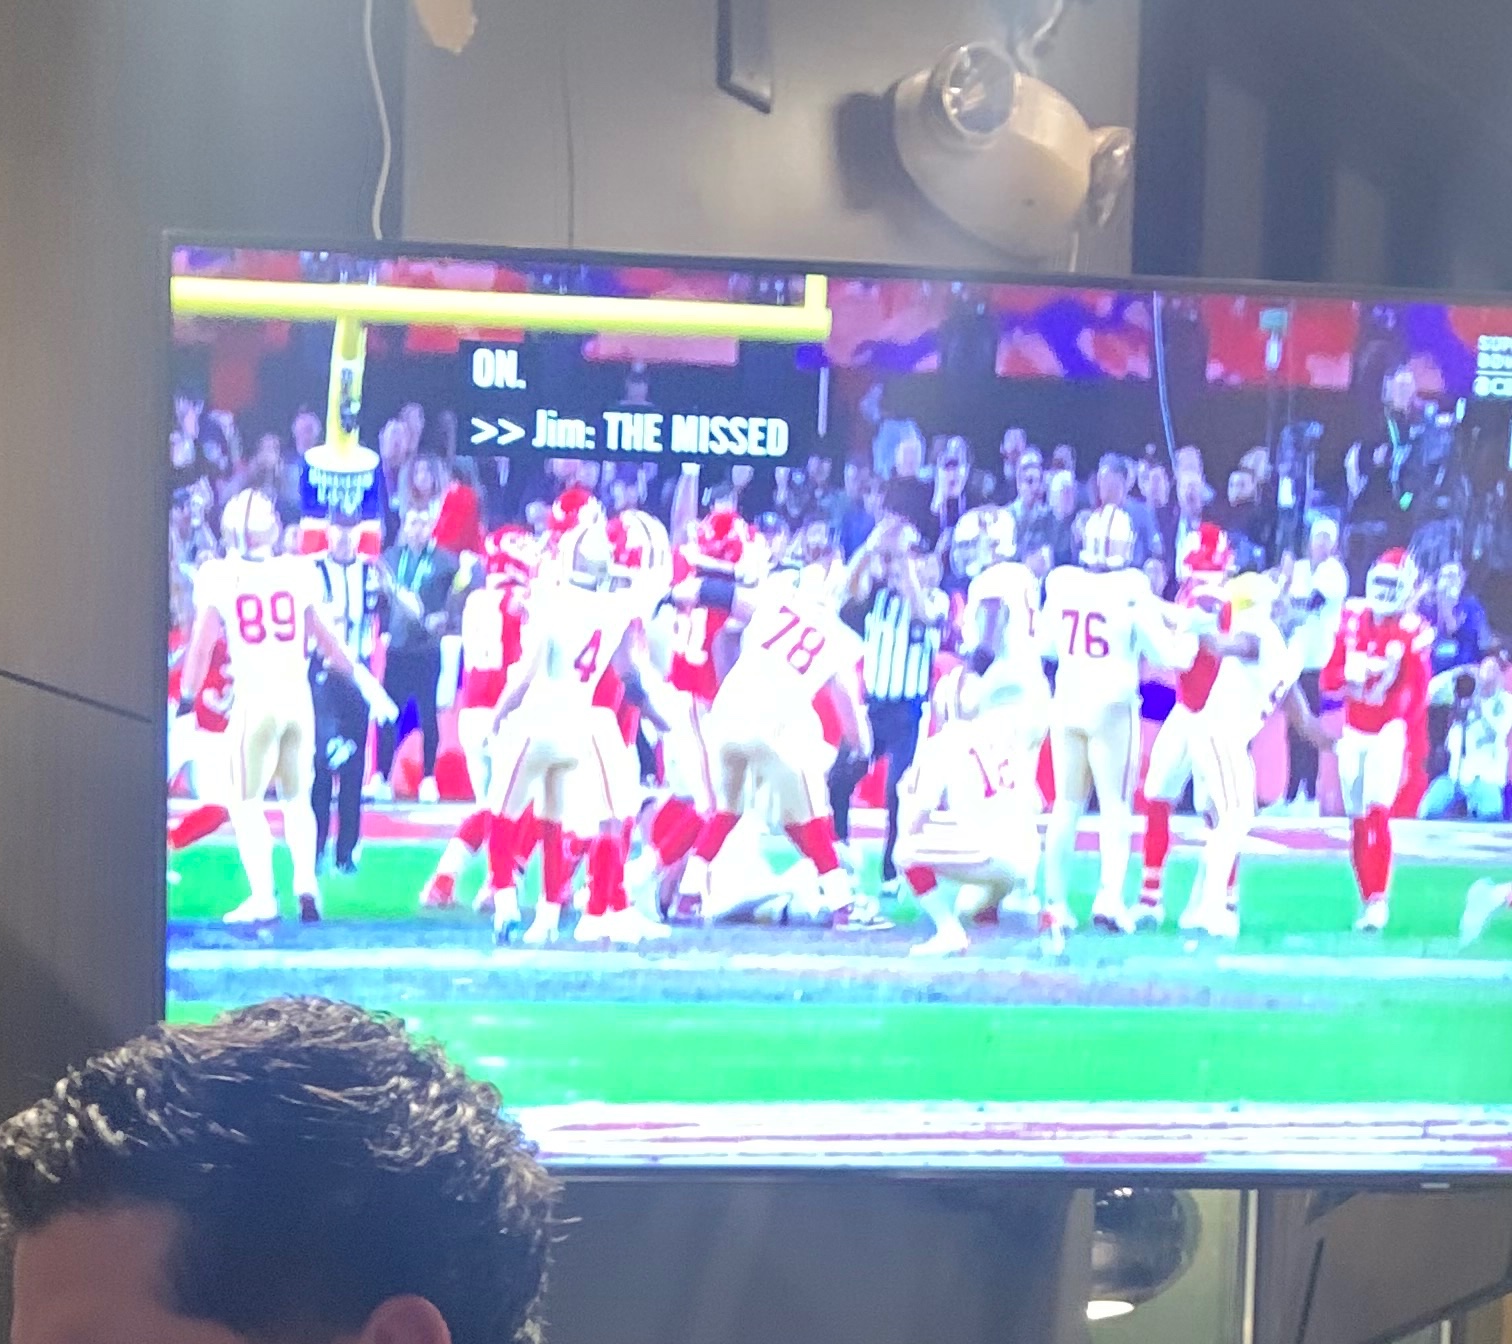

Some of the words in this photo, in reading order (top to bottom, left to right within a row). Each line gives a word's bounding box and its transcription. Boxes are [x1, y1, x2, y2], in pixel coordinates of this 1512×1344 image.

[471, 347, 527, 390] ON.
[531, 408, 596, 450] Jim:
[603, 410, 664, 453] THE
[670, 413, 790, 457] MISSED
[235, 590, 296, 645] 89
[1061, 608, 1110, 659] 76
